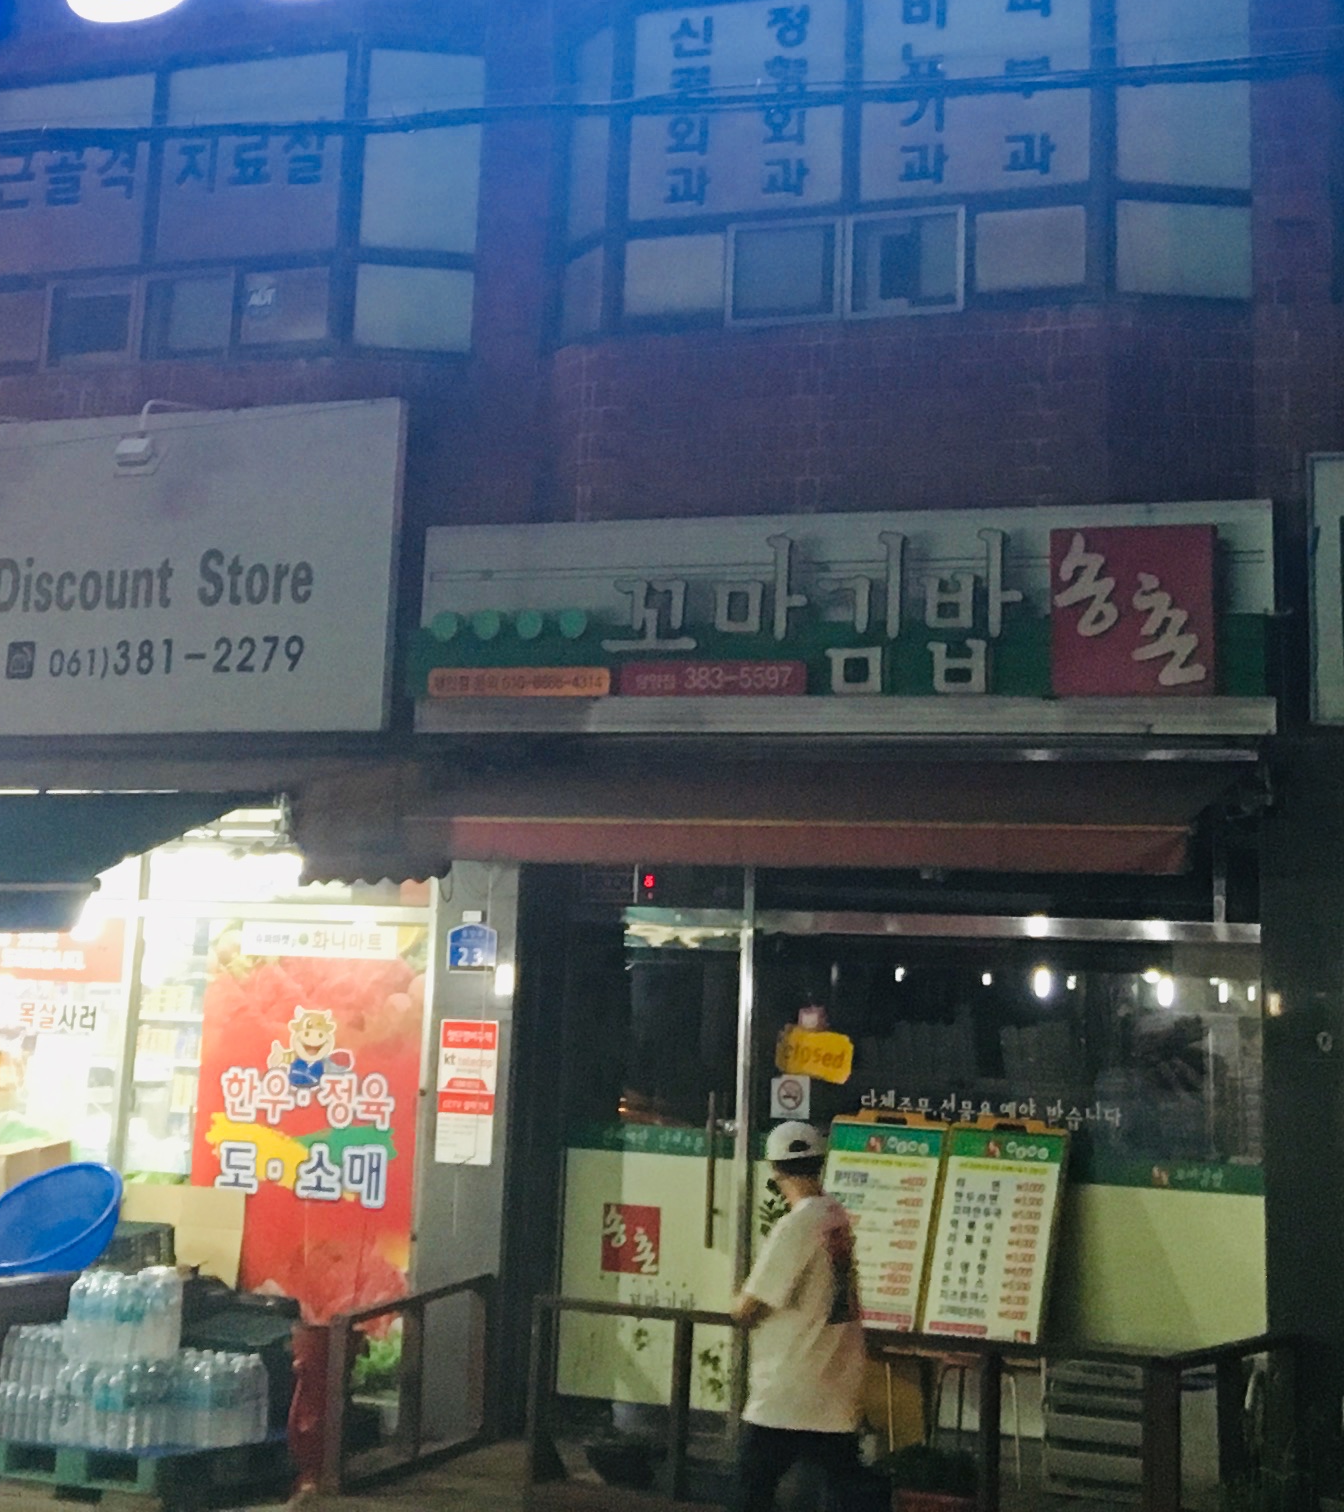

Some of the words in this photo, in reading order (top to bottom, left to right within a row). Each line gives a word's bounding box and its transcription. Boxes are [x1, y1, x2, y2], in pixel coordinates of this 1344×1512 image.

[196, 547, 315, 608] Store
[600, 528, 1024, 695] 꼬마김밥
[1053, 533, 1209, 687] 송촌
[683, 665, 795, 690] 383-5597
[312, 929, 383, 952] 화니마트
[457, 946, 484, 967] 23
[444, 1052, 456, 1065] kt
[783, 1042, 847, 1070] closed
[999, 1097, 1037, 1121] 예약
[601, 1203, 660, 1275] 송촌
